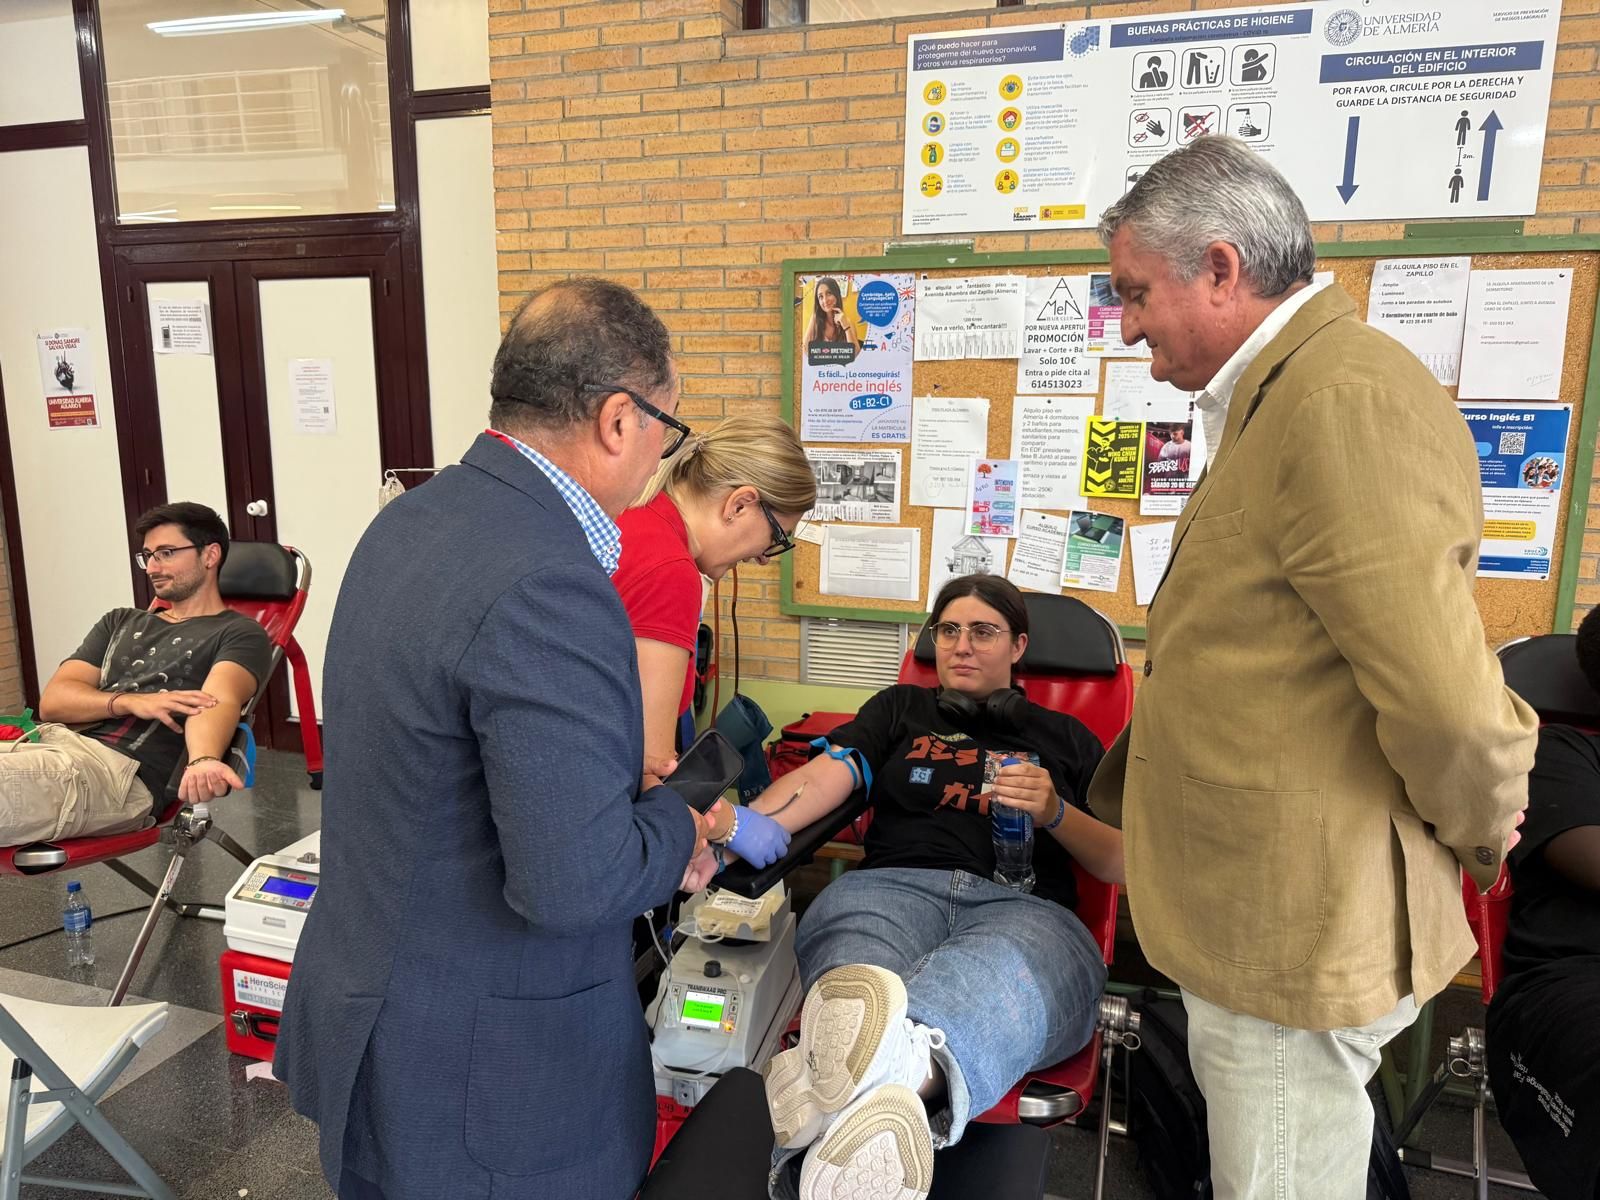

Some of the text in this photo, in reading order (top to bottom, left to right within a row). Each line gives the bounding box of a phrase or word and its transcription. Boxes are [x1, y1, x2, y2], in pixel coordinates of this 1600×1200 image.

[1127, 25, 1169, 36] BUENAS
[1172, 20, 1231, 33] PRÁCTICAS
[1235, 19, 1247, 28] DE
[1251, 15, 1294, 26] HIGIENE
[1364, 12, 1441, 26] UNIVERSIDAD
[1363, 22, 1440, 36] DE ALMERÍA
[918, 40, 998, 53] ¿Qué puedo hacer para
[918, 45, 1037, 61] protegerme del nuevo coronavirus
[923, 60, 941, 68] otros
[941, 58, 958, 67] virus
[959, 55, 1006, 66] respiratorios?
[1346, 47, 1516, 66] CIRCULACIÓN EN EL INTERIOR
[1393, 62, 1467, 75] DEL EDIFICIO
[1333, 76, 1524, 96] POR FAVOR, CIRCULE POR LA DERECHA Y
[1336, 90, 1517, 107] GUARDE LA DISTANCIA DE SEGURIDAD
[1027, 332, 1084, 343] PROMOCIÓN
[1039, 356, 1077, 365] Solo 10€
[858, 371, 900, 379] conseguirás!
[1051, 369, 1066, 377] pide
[1083, 368, 1090, 376] al
[813, 380, 902, 394] Aprende inglés
[1031, 380, 1083, 389] 614513023
[1489, 412, 1521, 422] Inglés
[250, 976, 286, 991] HeraScie
